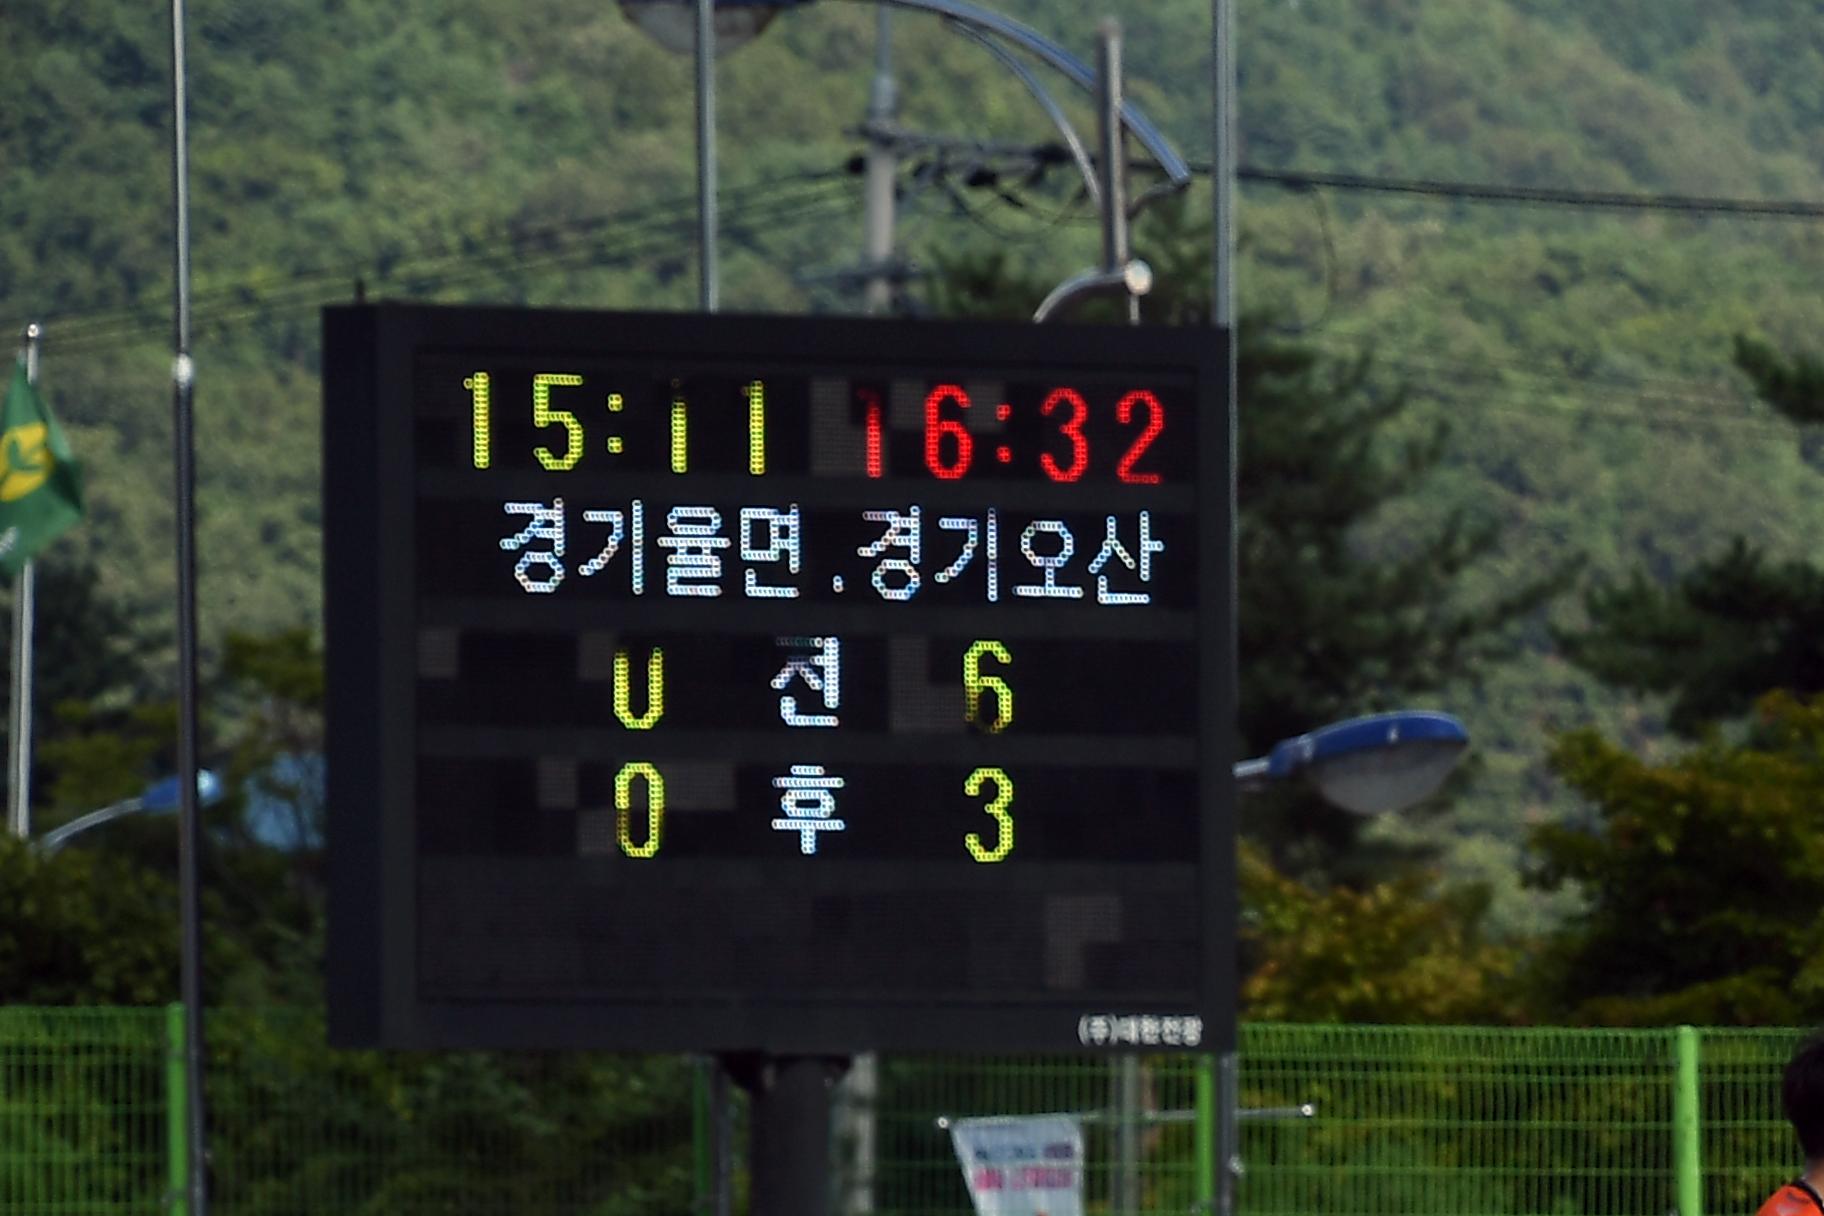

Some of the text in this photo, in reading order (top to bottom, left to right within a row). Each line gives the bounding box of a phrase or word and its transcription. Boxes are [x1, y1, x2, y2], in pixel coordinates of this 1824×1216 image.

[464, 372, 1166, 485] 15:11 16:32
[964, 640, 1013, 733] 6
[614, 762, 1014, 863] 0 후 3
